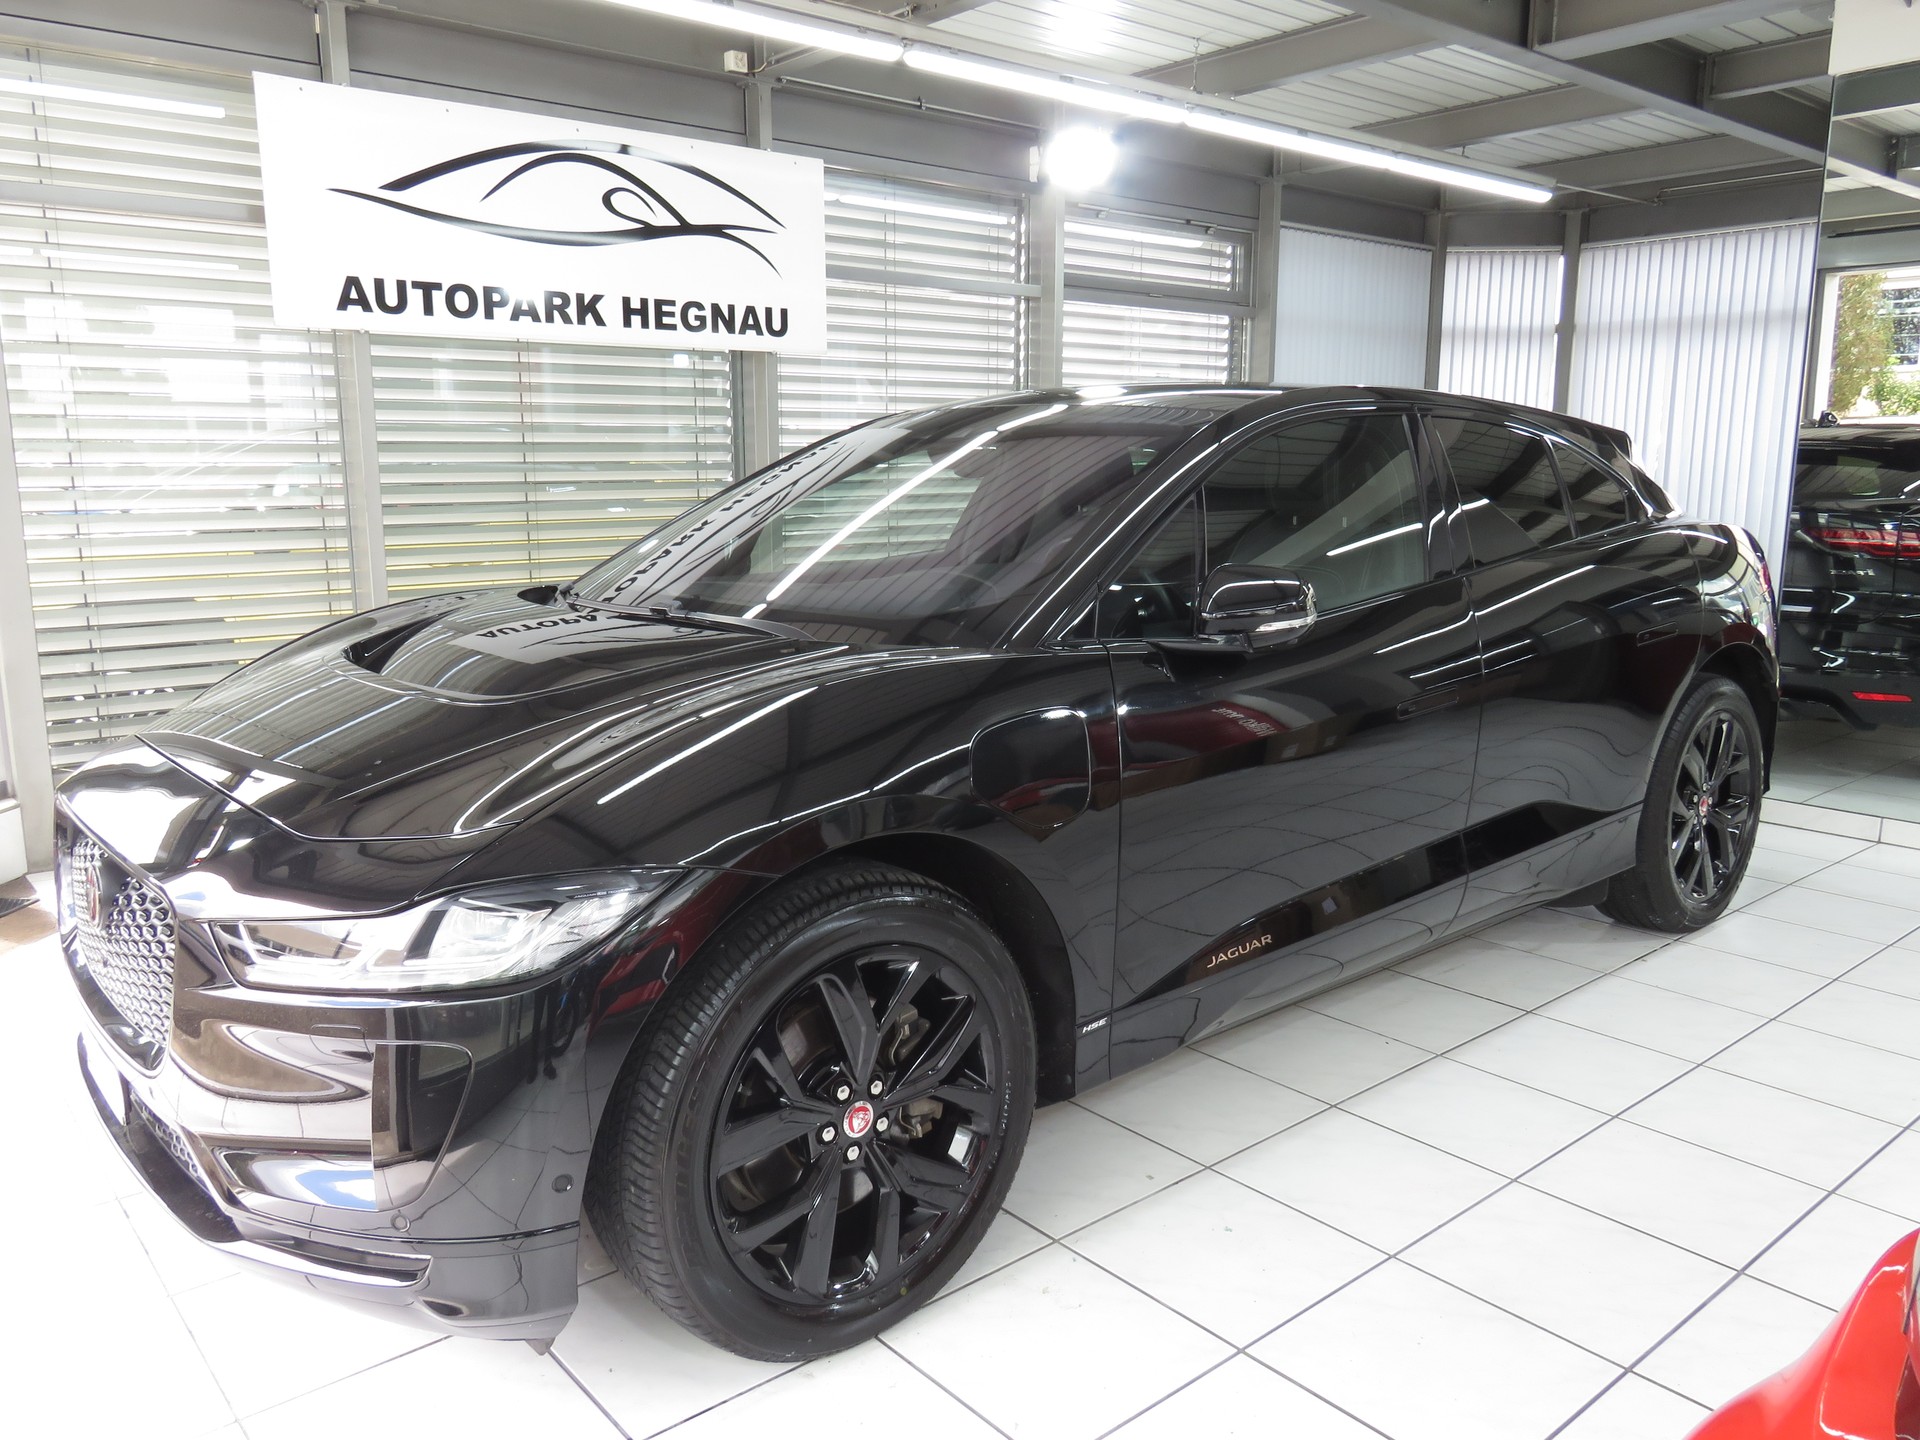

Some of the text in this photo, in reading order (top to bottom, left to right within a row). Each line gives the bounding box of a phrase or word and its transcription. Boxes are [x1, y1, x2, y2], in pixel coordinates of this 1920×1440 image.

[336, 275, 789, 338] AUTOPARK HEGNAU
[1206, 934, 1273, 968] JAGUAR
[1081, 1017, 1108, 1034] HSE
